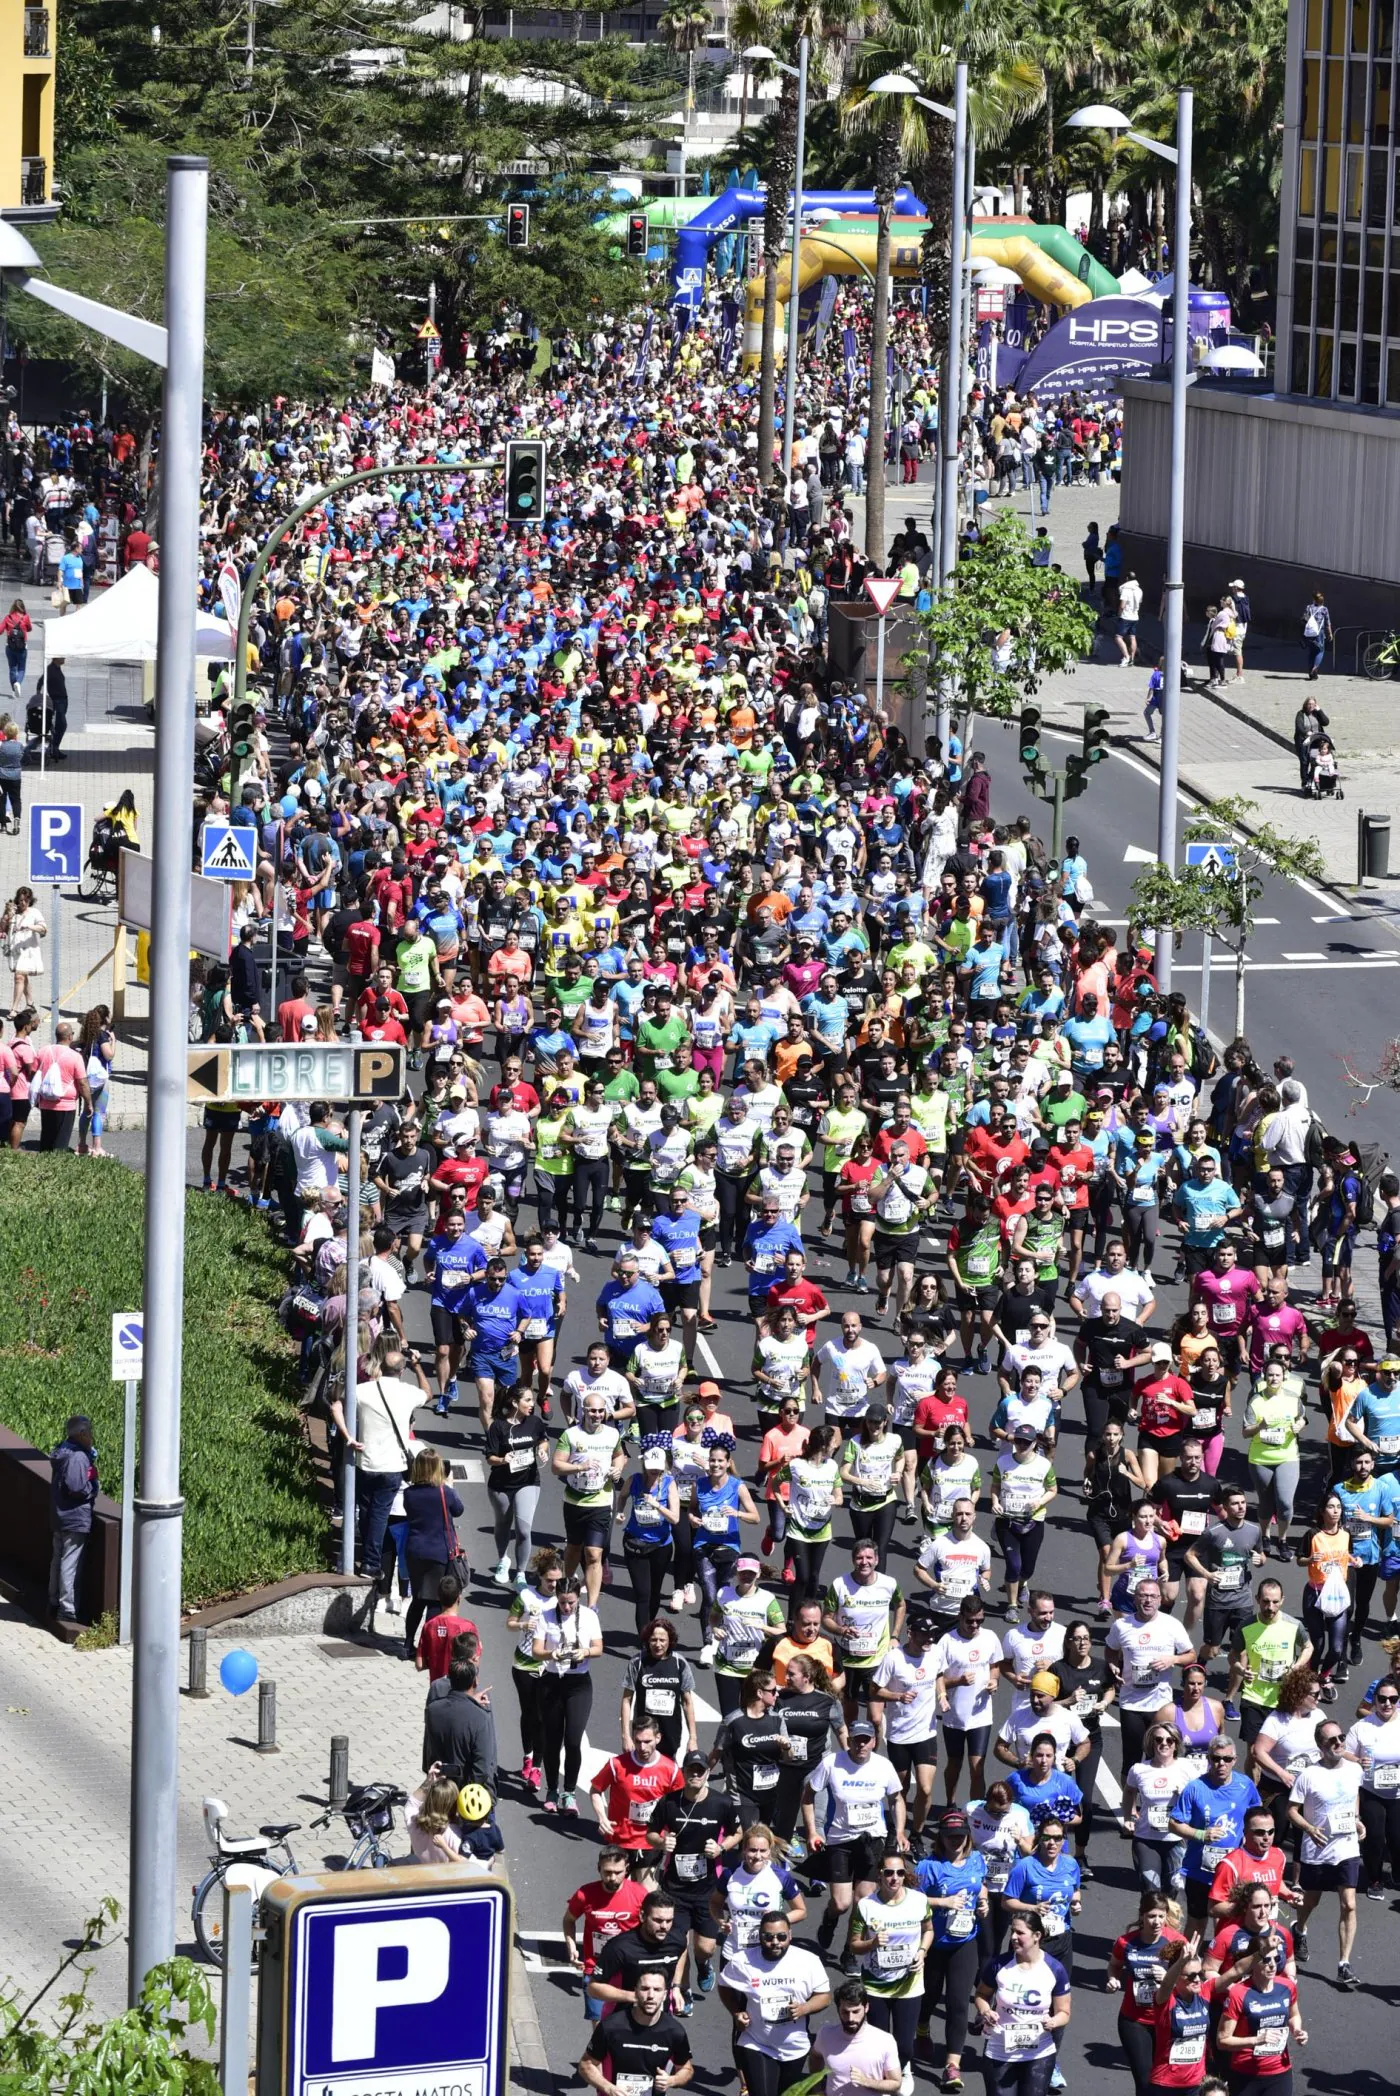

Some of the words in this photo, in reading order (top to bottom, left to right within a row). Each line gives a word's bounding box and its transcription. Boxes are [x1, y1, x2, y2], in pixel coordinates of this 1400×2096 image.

[1069, 318, 1159, 342] HPS
[1044, 379, 1062, 387] HPS
[41, 810, 71, 850] P
[232, 1051, 344, 1095] LIBRE
[360, 1052, 394, 1094] P
[476, 1306, 511, 1315] GLOBAL
[608, 1301, 640, 1312] GLOBAL
[784, 1710, 819, 1718] CONTACTEL
[632, 1775, 658, 1788] Bull
[842, 1780, 877, 1788] MRW
[1252, 1868, 1277, 1883] Bull
[887, 1955, 904, 1964] 4562
[761, 1976, 796, 1986] WÜRTH
[331, 1917, 450, 2063] P
